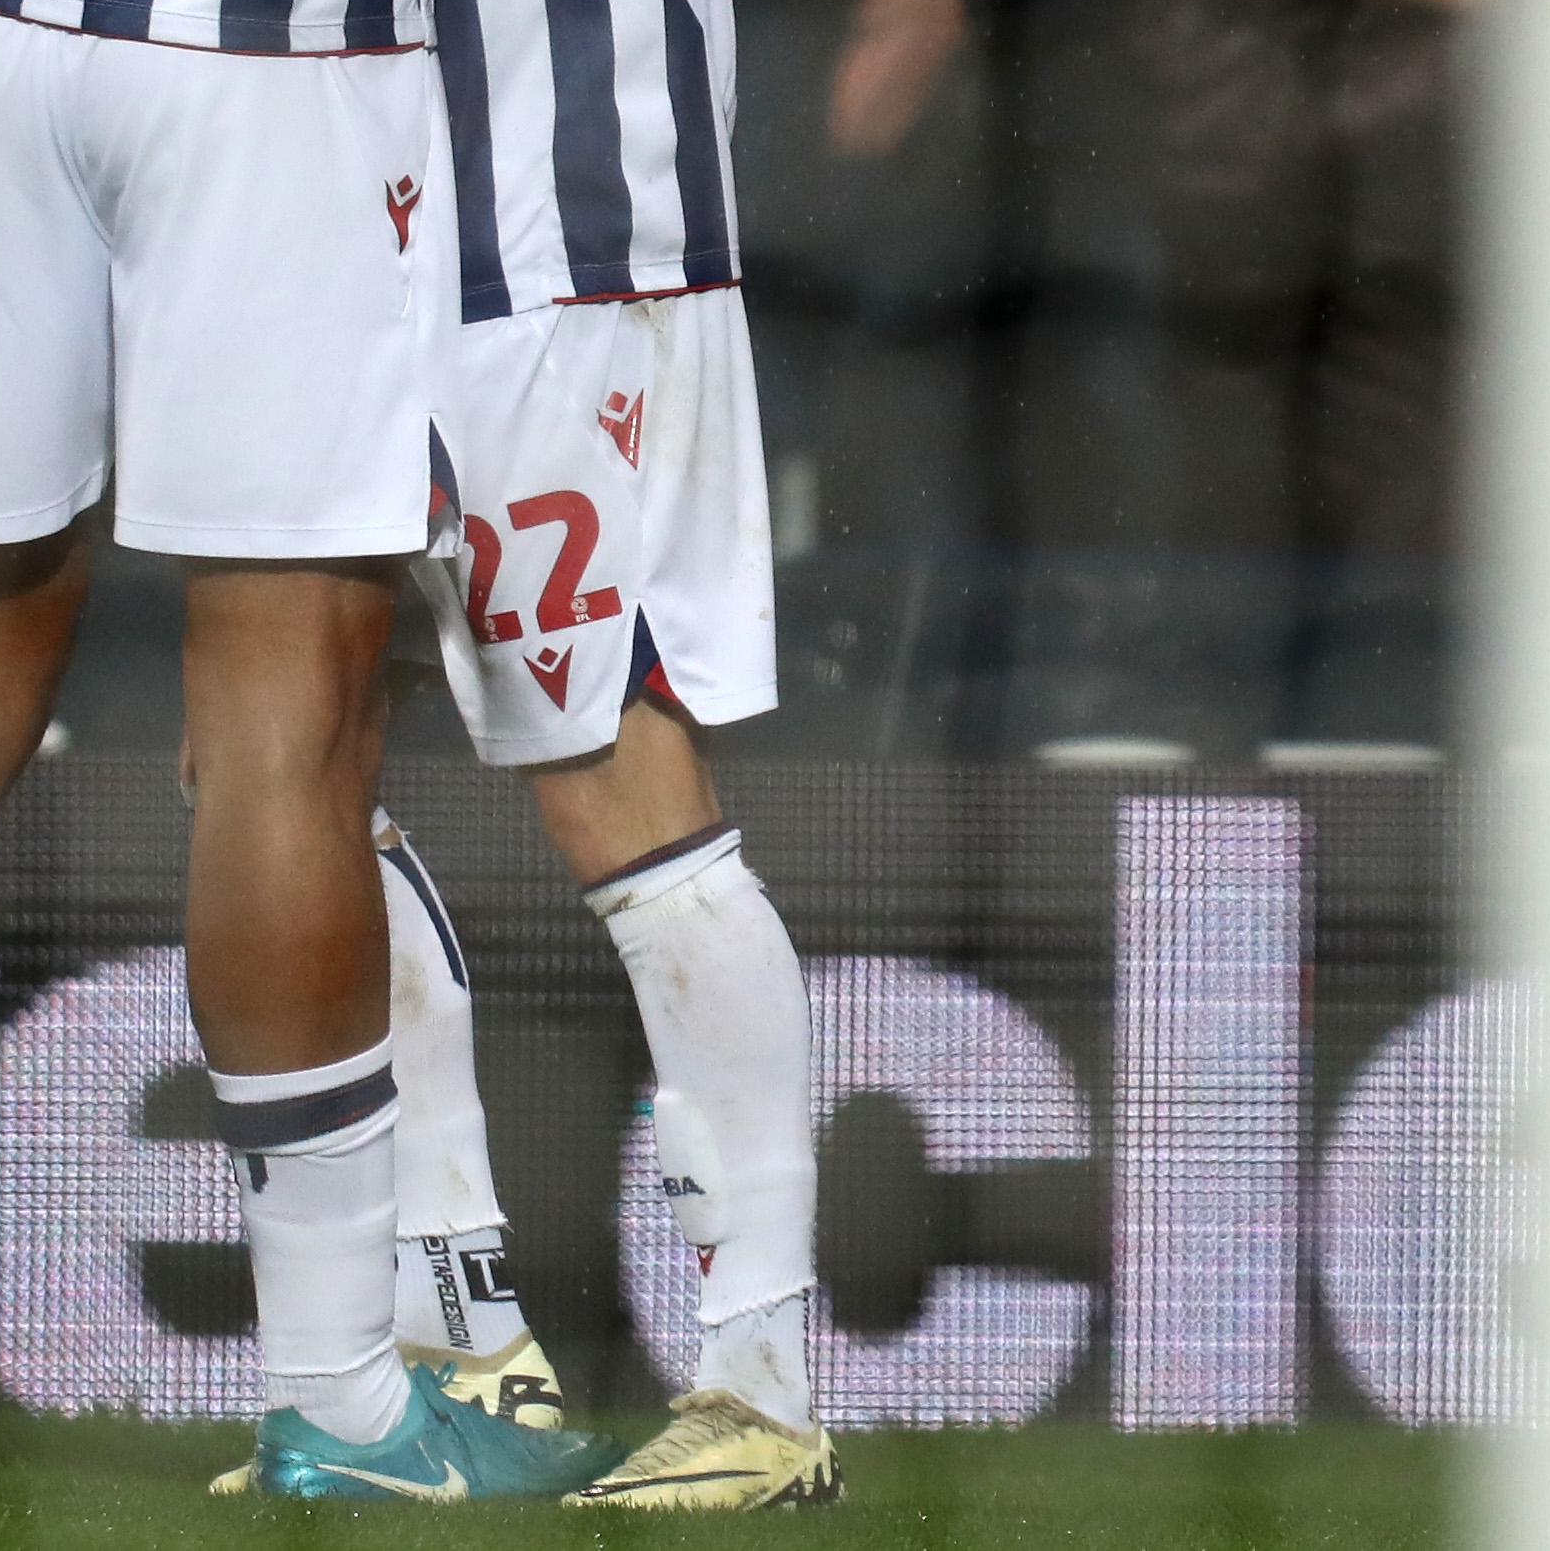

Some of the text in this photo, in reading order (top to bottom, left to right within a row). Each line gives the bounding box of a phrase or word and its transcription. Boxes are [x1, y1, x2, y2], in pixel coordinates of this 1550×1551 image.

[461, 490, 623, 646] 22
[575, 613, 592, 624] EFL
[662, 1175, 707, 1198] BA
[427, 1253, 474, 1351] TAPEDESIGN
